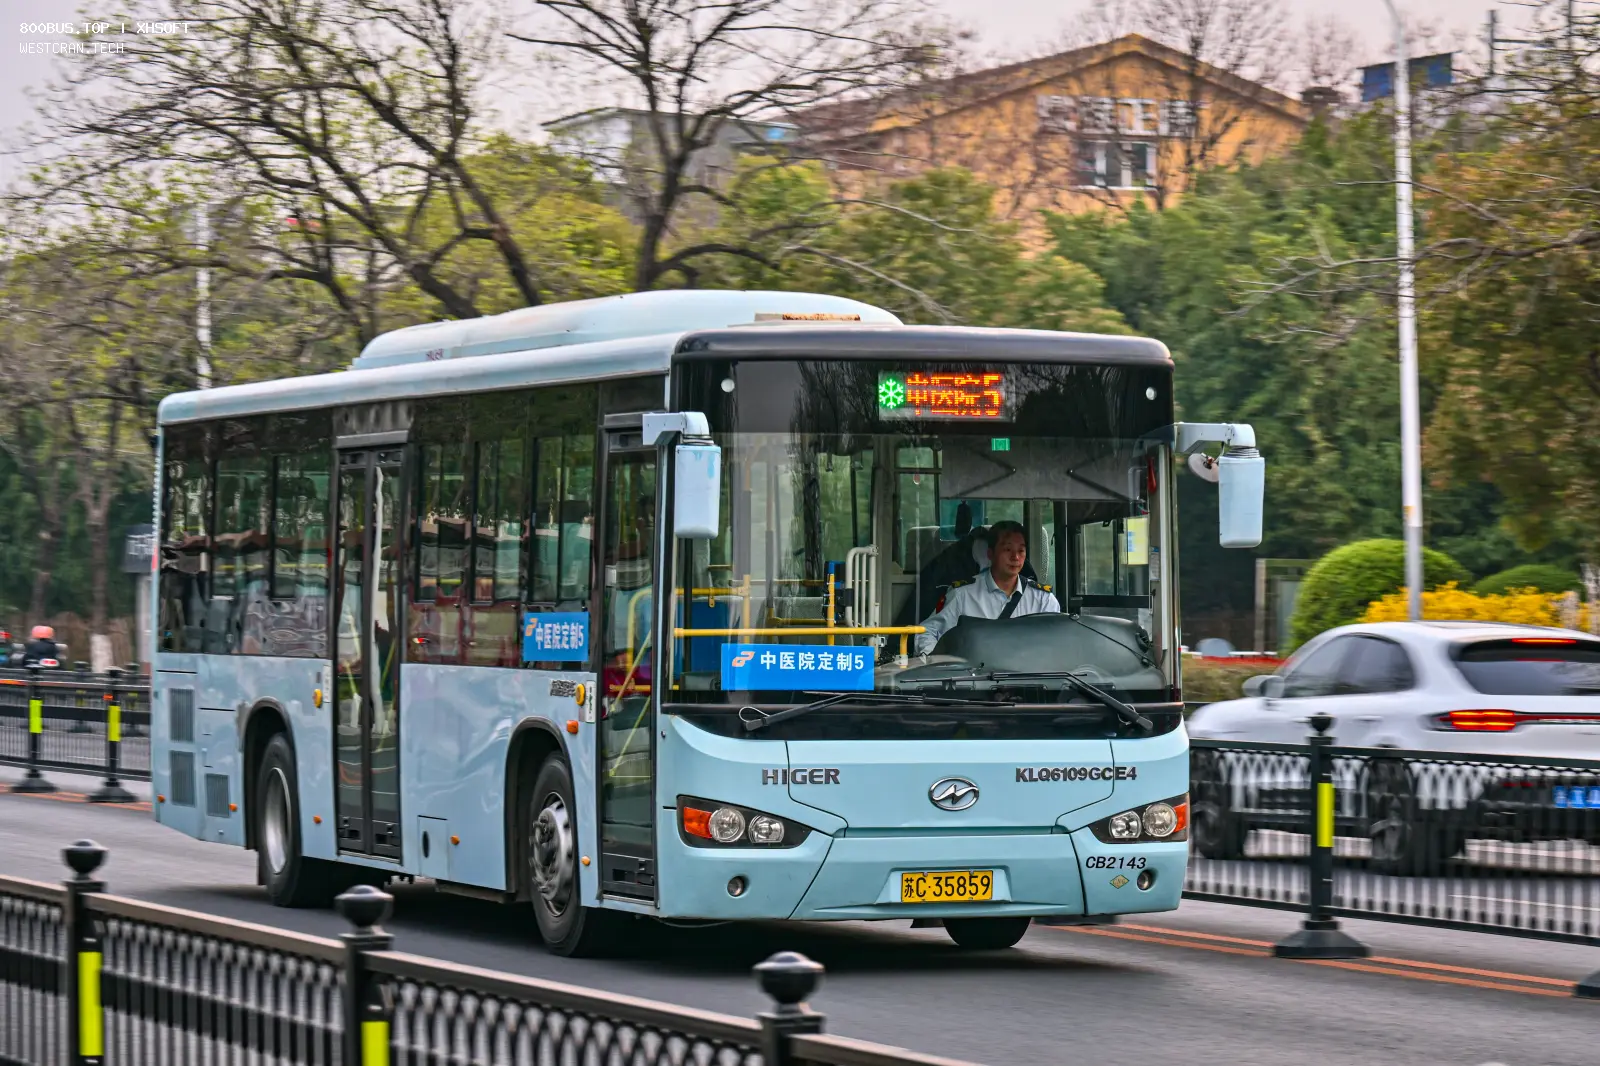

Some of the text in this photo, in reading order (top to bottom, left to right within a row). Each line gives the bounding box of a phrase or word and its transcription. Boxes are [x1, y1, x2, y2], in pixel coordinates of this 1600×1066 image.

[535, 622, 584, 650] 中医院定制5
[760, 651, 864, 671] 中医院定制5
[762, 768, 840, 785] HIGER
[1015, 766, 1137, 782] KLQ6109GCE4
[1085, 856, 1147, 869] CB2143
